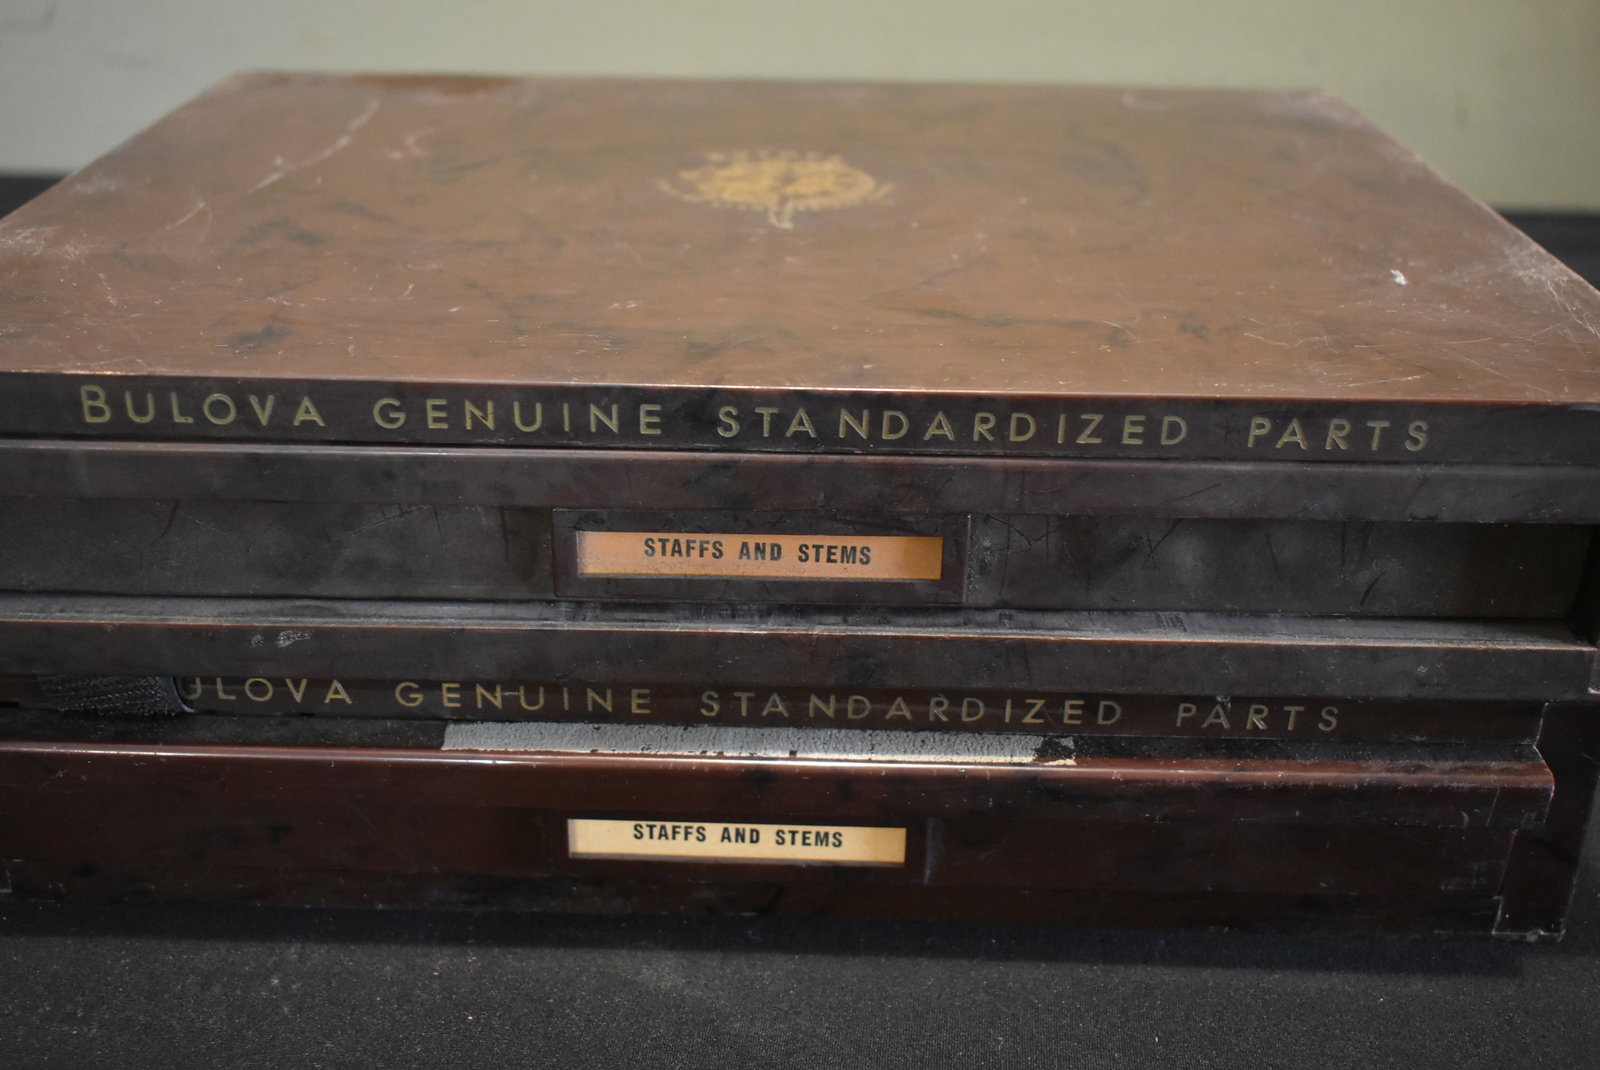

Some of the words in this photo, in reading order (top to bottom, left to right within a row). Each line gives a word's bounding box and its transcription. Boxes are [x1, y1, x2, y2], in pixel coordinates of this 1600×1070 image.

[80, 384, 325, 427] BULOVA
[372, 396, 664, 436] GENUINE
[716, 404, 1188, 446] STANDARDIZED
[1247, 415, 1430, 452] PARTS
[643, 536, 725, 560] STAFFS
[738, 541, 782, 562] AND
[797, 543, 873, 565] STEMS
[394, 681, 652, 714] GENUINE
[699, 690, 1123, 726] STANDARDIZED
[1175, 701, 1340, 732] PARTS
[632, 823, 707, 842] STAFFS
[720, 827, 761, 844] AND
[775, 829, 844, 848] STEMS
